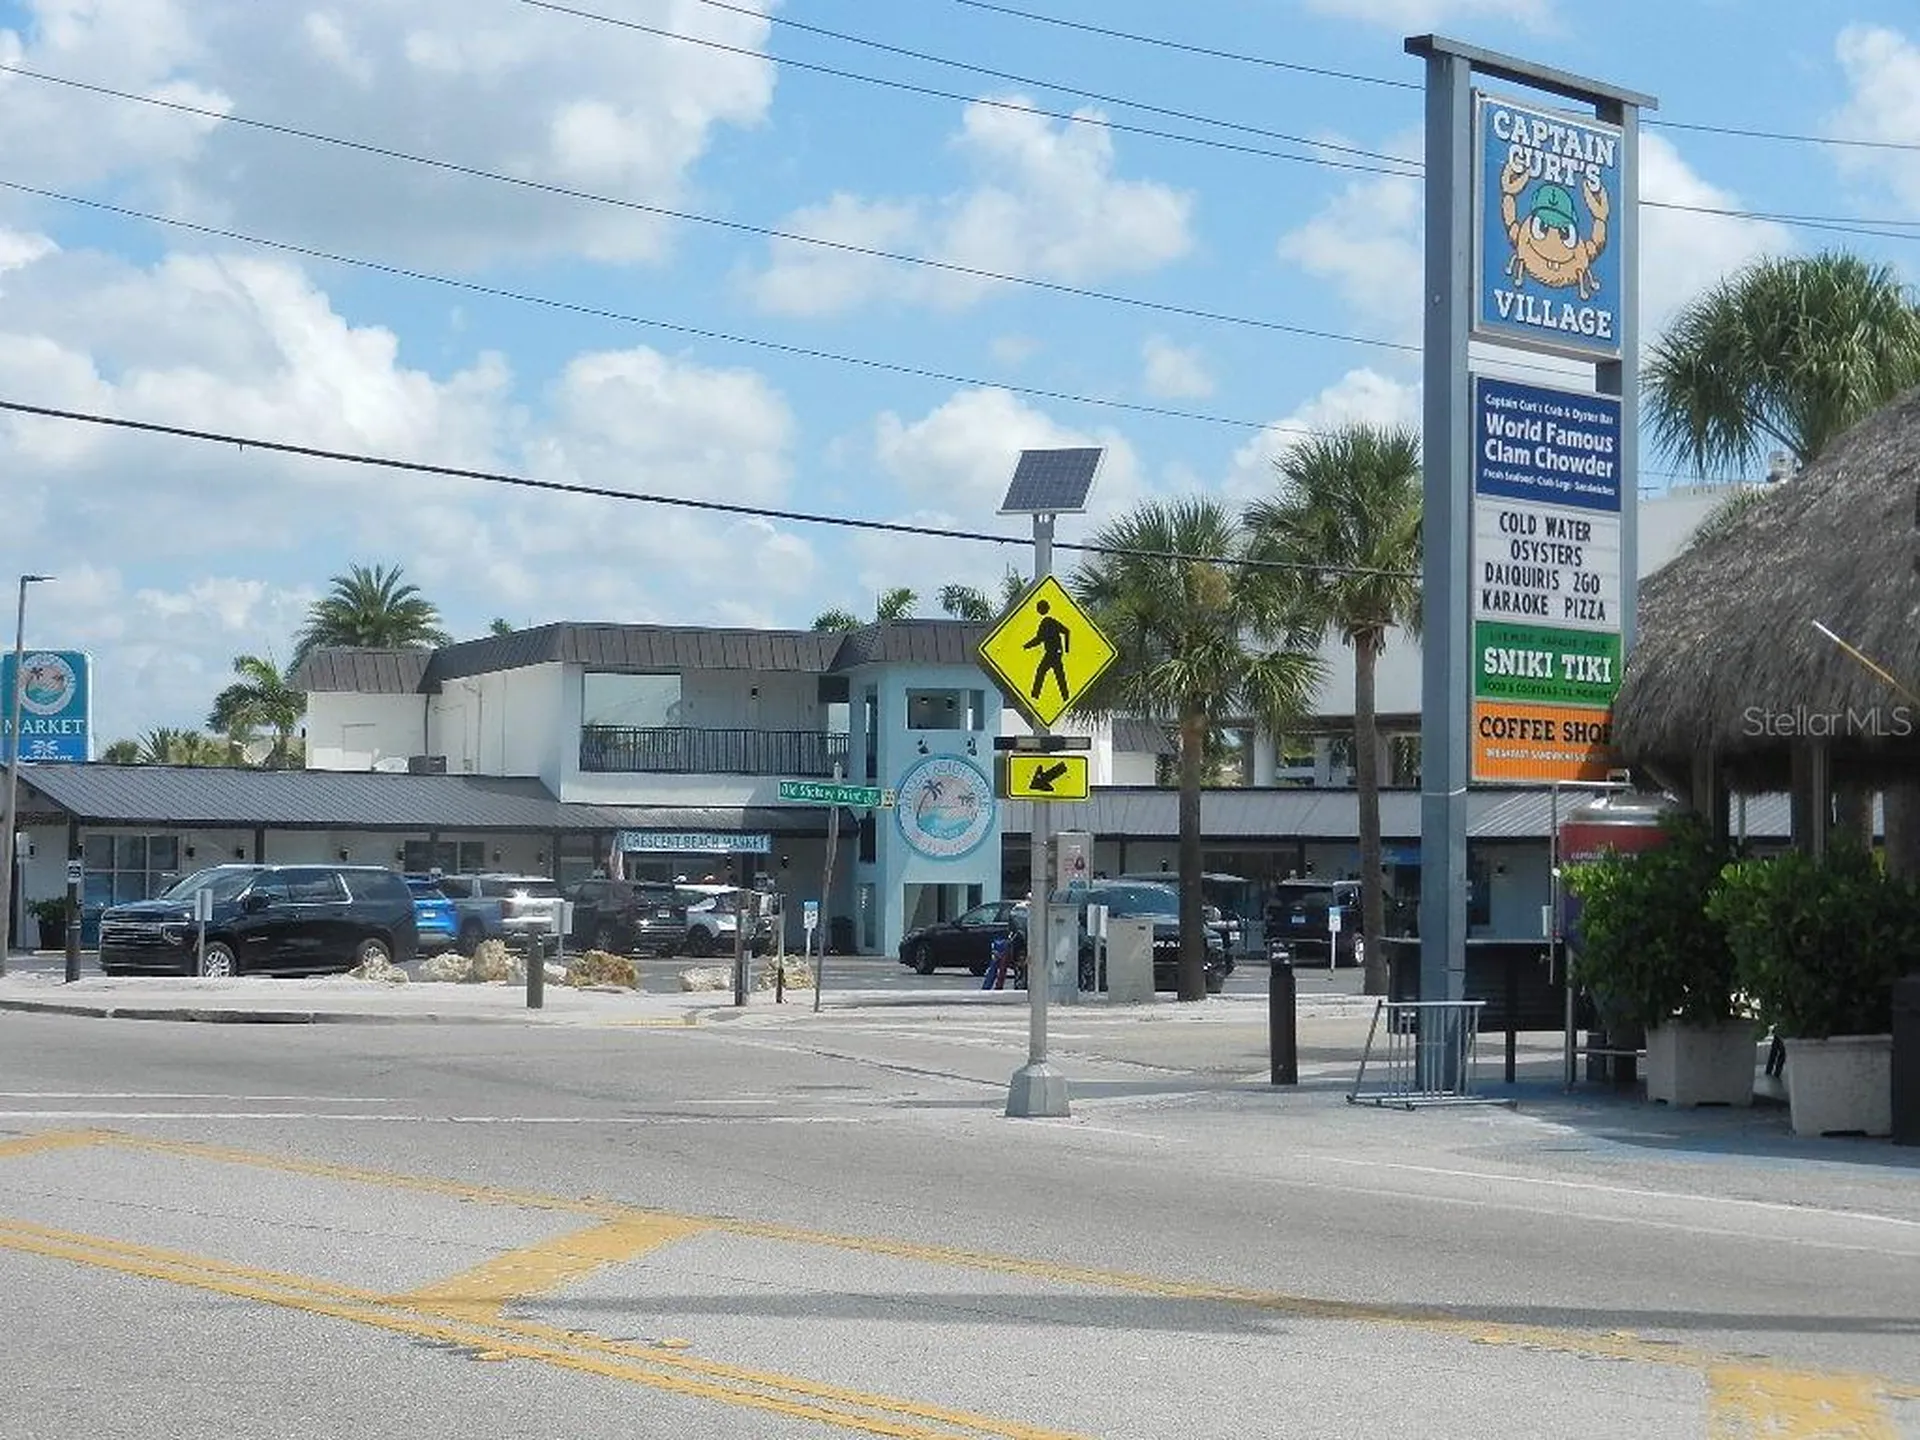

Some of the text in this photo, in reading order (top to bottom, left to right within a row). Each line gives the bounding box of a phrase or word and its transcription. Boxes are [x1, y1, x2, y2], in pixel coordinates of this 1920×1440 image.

[1493, 109, 1616, 169] CAPTAIN
[1493, 289, 1612, 339] VILLAGE
[1485, 412, 1614, 454] World Famous
[1485, 438, 1614, 478] Clam Chowder
[1500, 511, 1592, 543] COLD WATER
[1510, 539, 1583, 568] OSYSTERS
[1485, 562, 1601, 595] DAIQUIRIS 2GO
[1482, 589, 1607, 622] KARAOKE PIZZA
[1484, 646, 1613, 684] SNIKI TIKI
[1479, 715, 1556, 742] COFFEE
